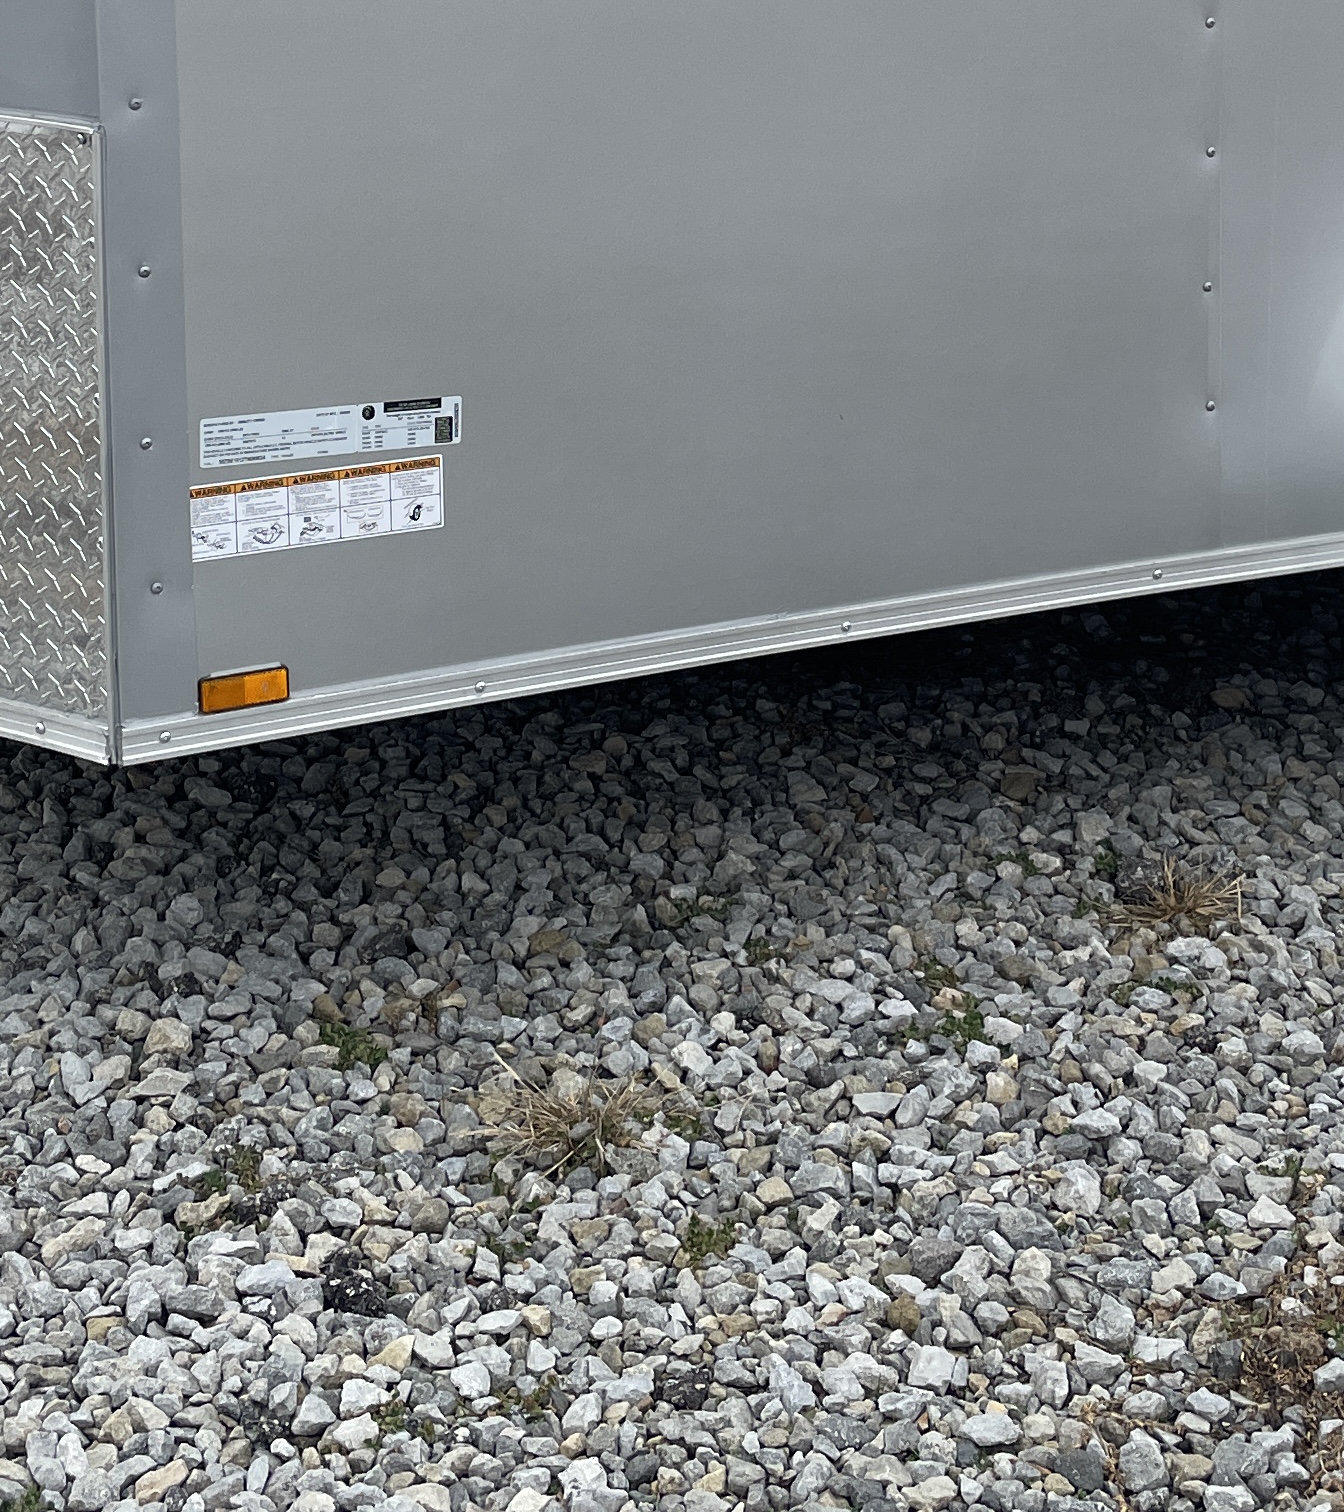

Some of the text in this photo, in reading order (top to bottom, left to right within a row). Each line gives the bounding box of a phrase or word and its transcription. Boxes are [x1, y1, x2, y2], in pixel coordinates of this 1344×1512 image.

[299, 471, 336, 483] WARNING
[247, 478, 284, 490] WARNING
[194, 486, 232, 497] WARNING
